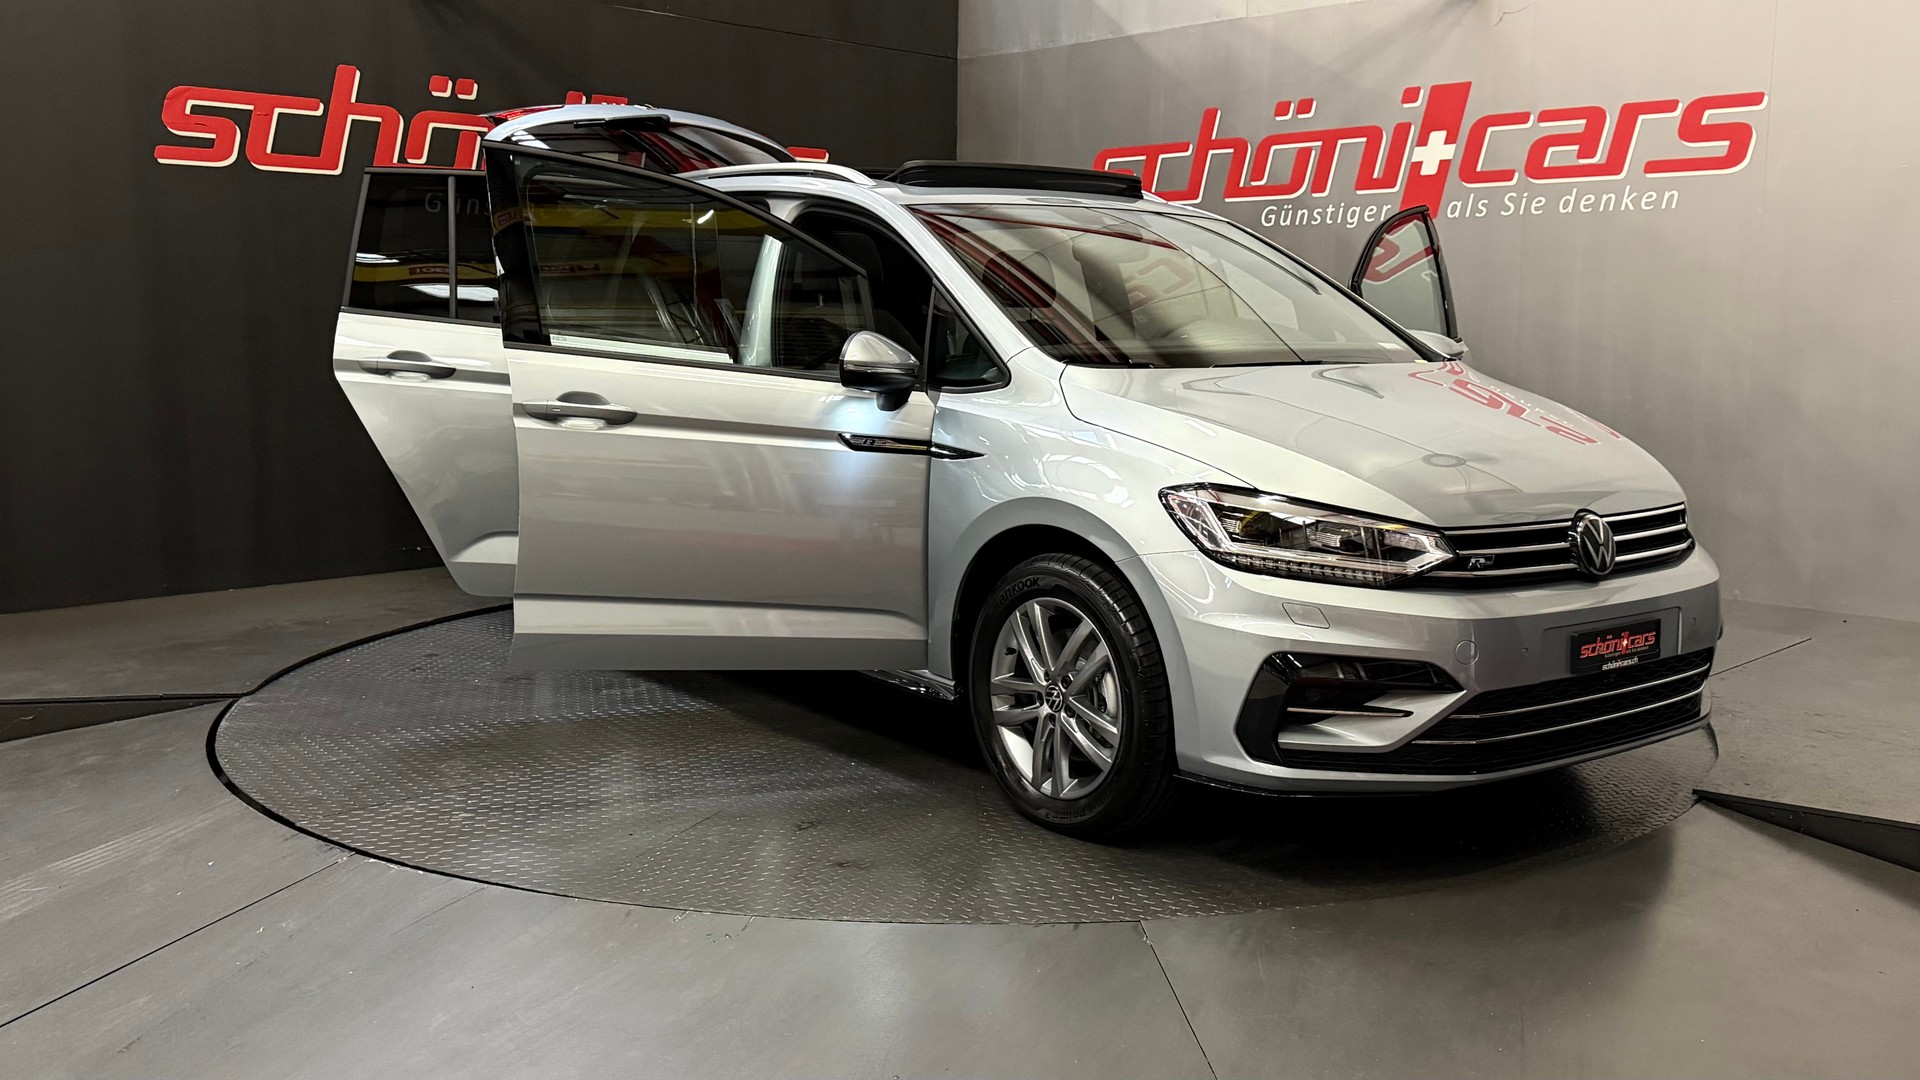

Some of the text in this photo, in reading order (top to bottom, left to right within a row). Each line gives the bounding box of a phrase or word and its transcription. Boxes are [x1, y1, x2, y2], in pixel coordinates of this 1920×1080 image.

[1459, 92, 1768, 187] cars
[1261, 185, 1679, 228] Günstiger als Sie denken
